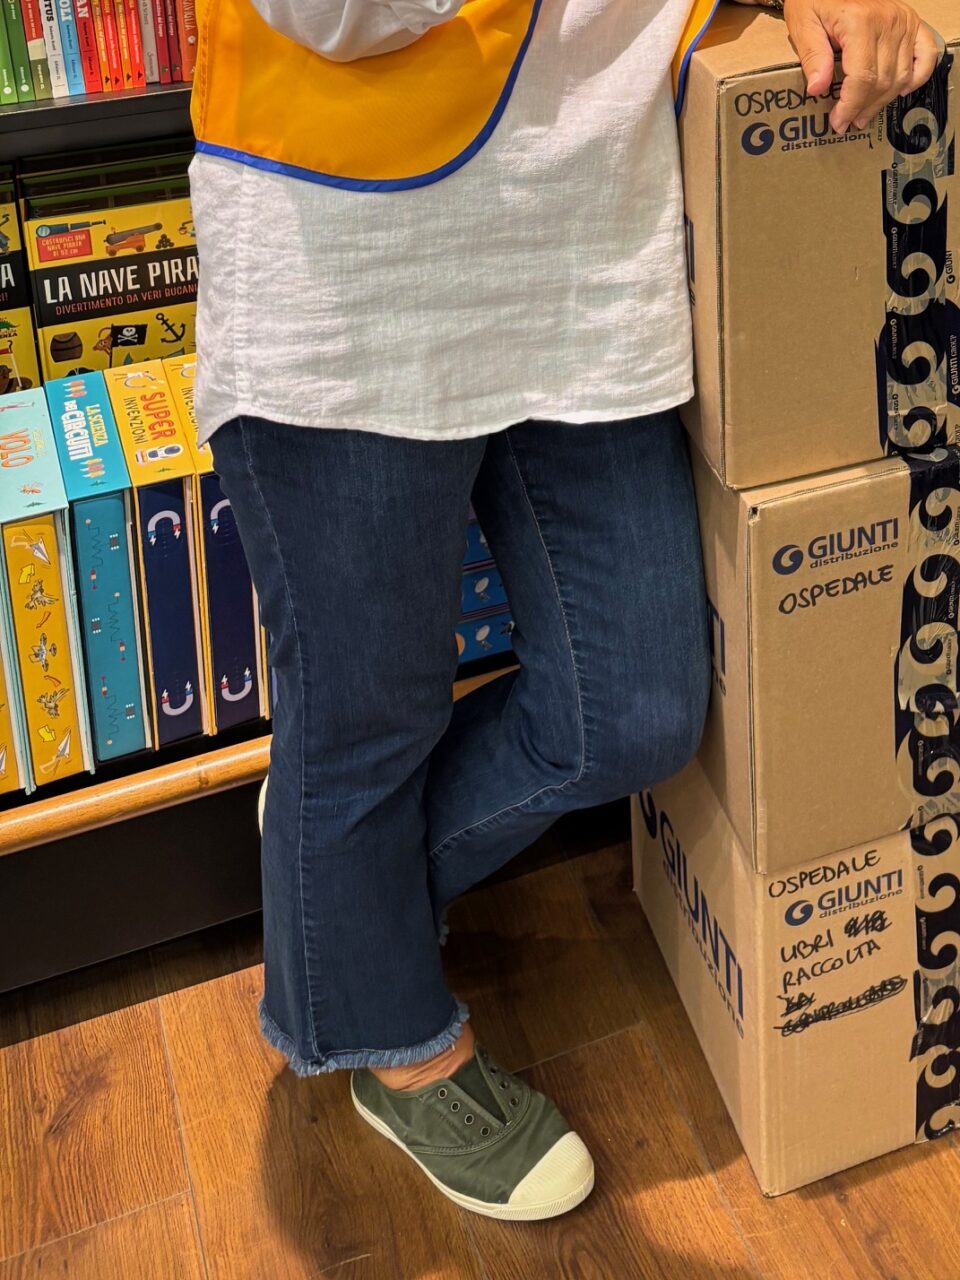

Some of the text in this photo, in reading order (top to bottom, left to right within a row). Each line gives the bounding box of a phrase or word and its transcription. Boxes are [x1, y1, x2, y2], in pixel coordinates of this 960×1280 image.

[43, 255, 200, 304] LA NAVE PIRA
[56, 289, 162, 316] DIVERTIMENTO DA VERI
[123, 396, 149, 445] INVENZIONI
[140, 391, 177, 441] SUPER
[807, 517, 899, 560] GIUNTI
[810, 541, 899, 570] distribuzione
[778, 565, 894, 614] OSPEDALE
[769, 849, 881, 899] OSPEDALE
[817, 869, 903, 911] GIUNTI
[660, 809, 743, 1020] GIUNTI
[818, 889, 903, 919] distribuzione
[783, 939, 881, 993] RACCOLTA
